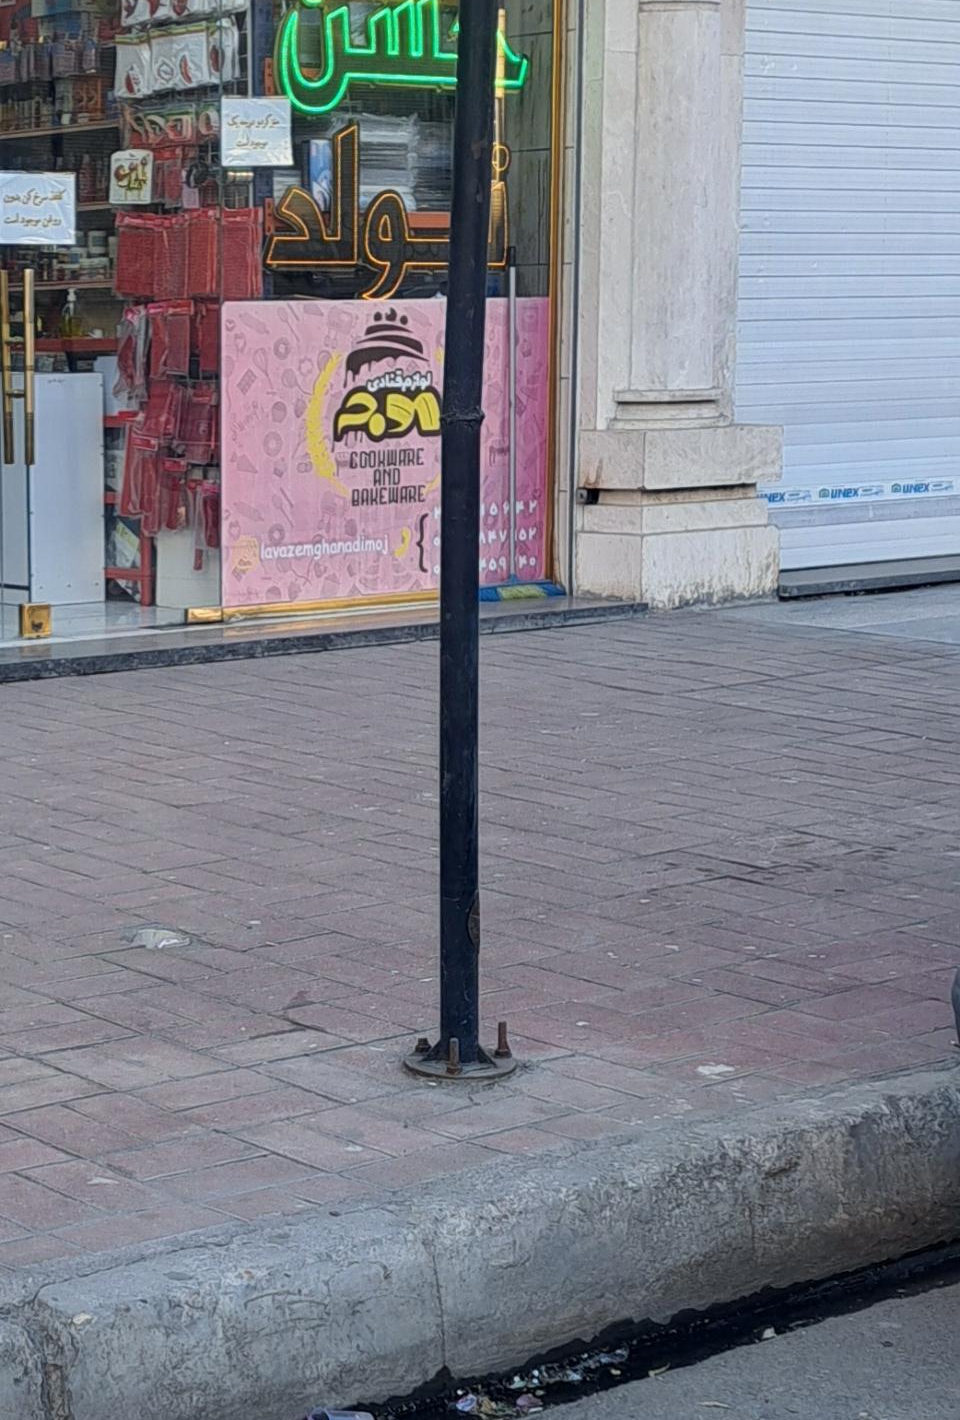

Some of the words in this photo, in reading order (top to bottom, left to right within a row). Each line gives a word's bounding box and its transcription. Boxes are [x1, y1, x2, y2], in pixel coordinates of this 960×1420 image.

[373, 468, 401, 486] AND
[351, 485, 426, 507] BAKEWARE
[260, 534, 388, 560] lavazemghanadimoj
